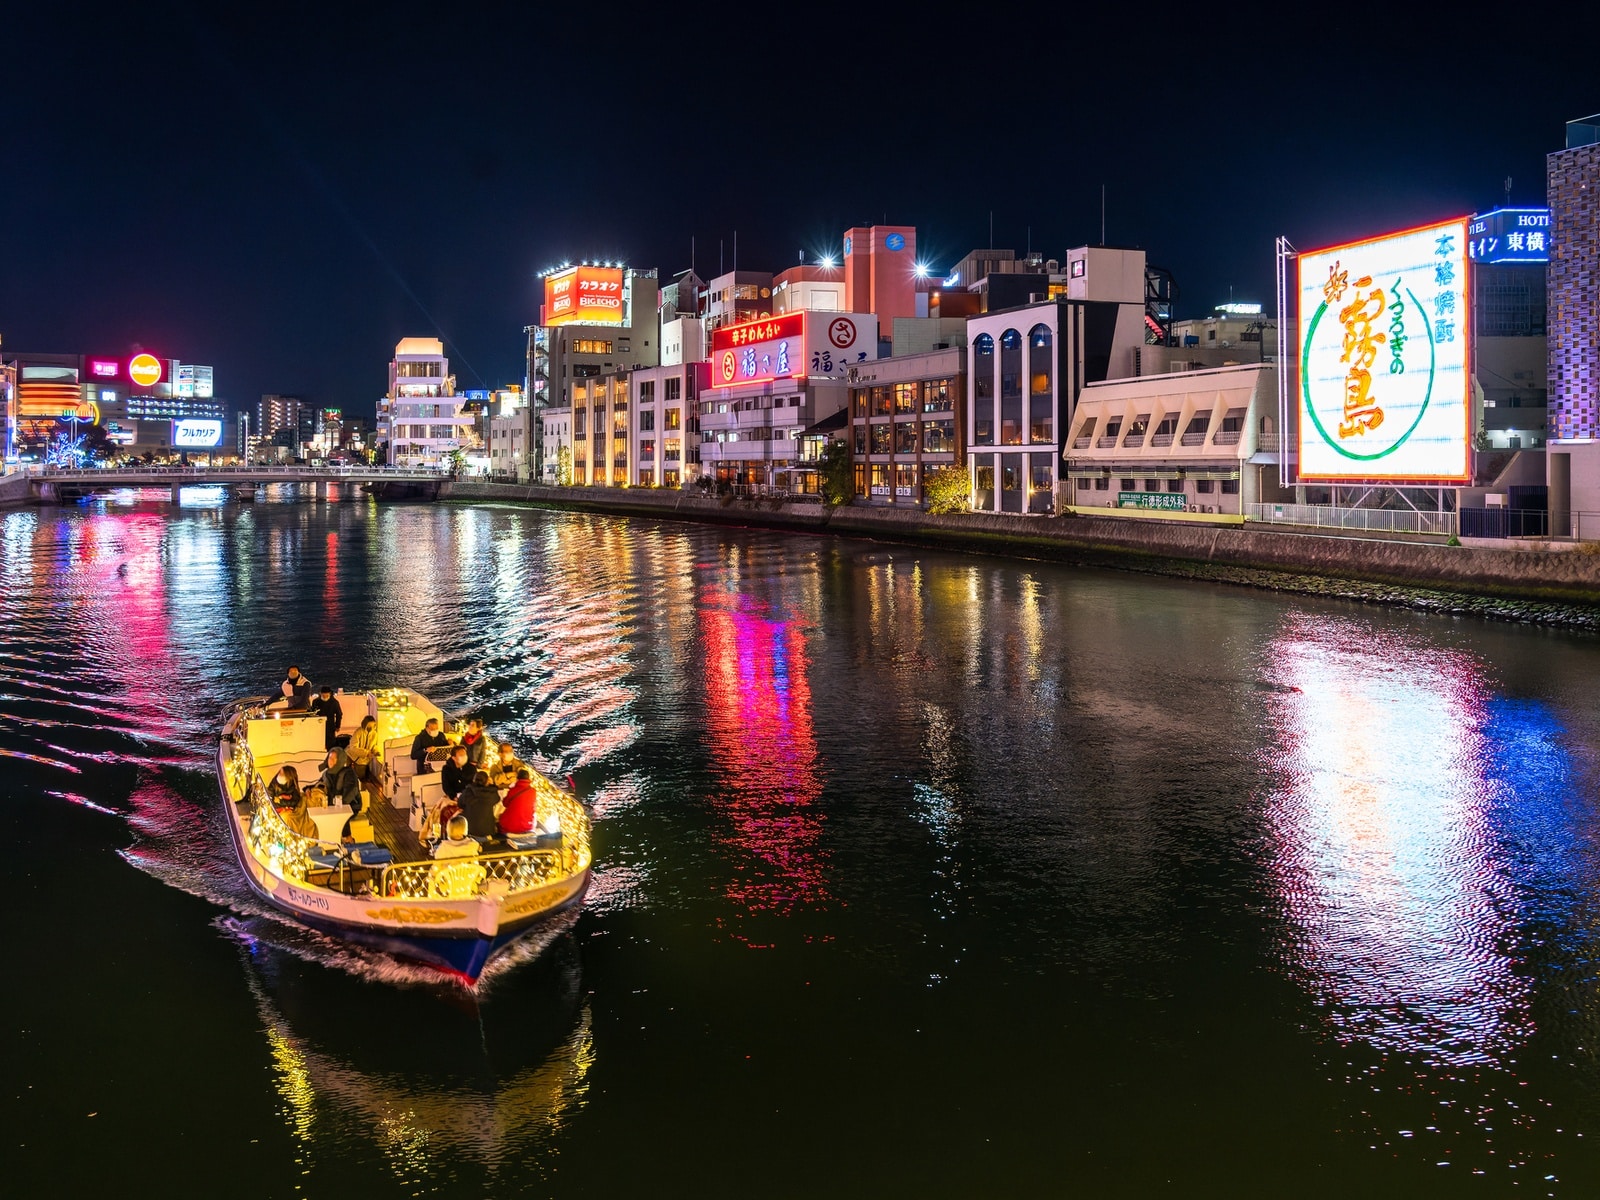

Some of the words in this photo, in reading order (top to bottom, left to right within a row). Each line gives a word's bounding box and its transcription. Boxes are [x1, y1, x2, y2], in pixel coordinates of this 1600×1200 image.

[580, 281, 619, 291] カラオケ
[1434, 234, 1456, 343] 本格焼酎
[580, 298, 596, 306] BIG
[597, 299, 620, 308] ECHO
[732, 325, 781, 346] 辛子めんたい
[1388, 276, 1408, 375] くつろぎの
[741, 341, 790, 377] 福さ屋
